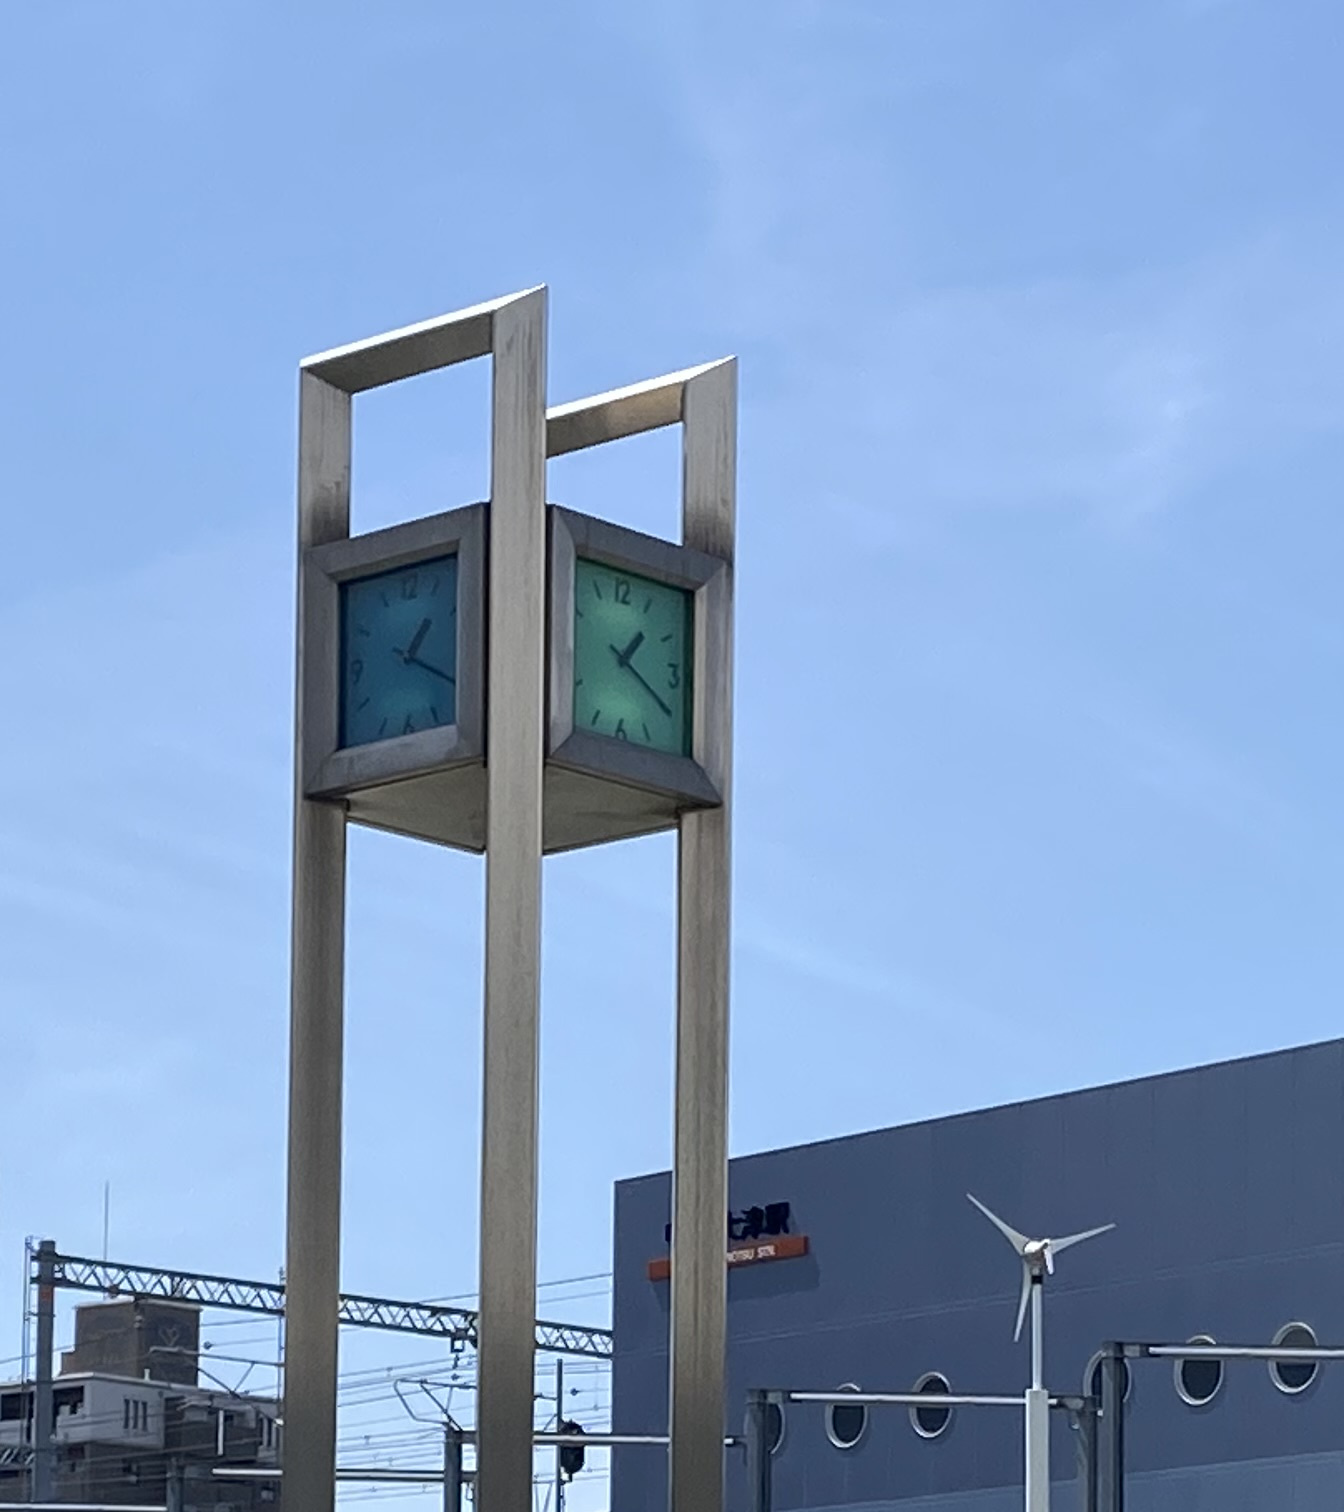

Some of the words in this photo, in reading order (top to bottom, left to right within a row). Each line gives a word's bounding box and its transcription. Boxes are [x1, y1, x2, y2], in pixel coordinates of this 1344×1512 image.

[402, 573, 418, 600] 12
[615, 578, 632, 605] 12
[351, 660, 363, 684] 9
[667, 663, 680, 689] 3
[616, 718, 628, 740] 6
